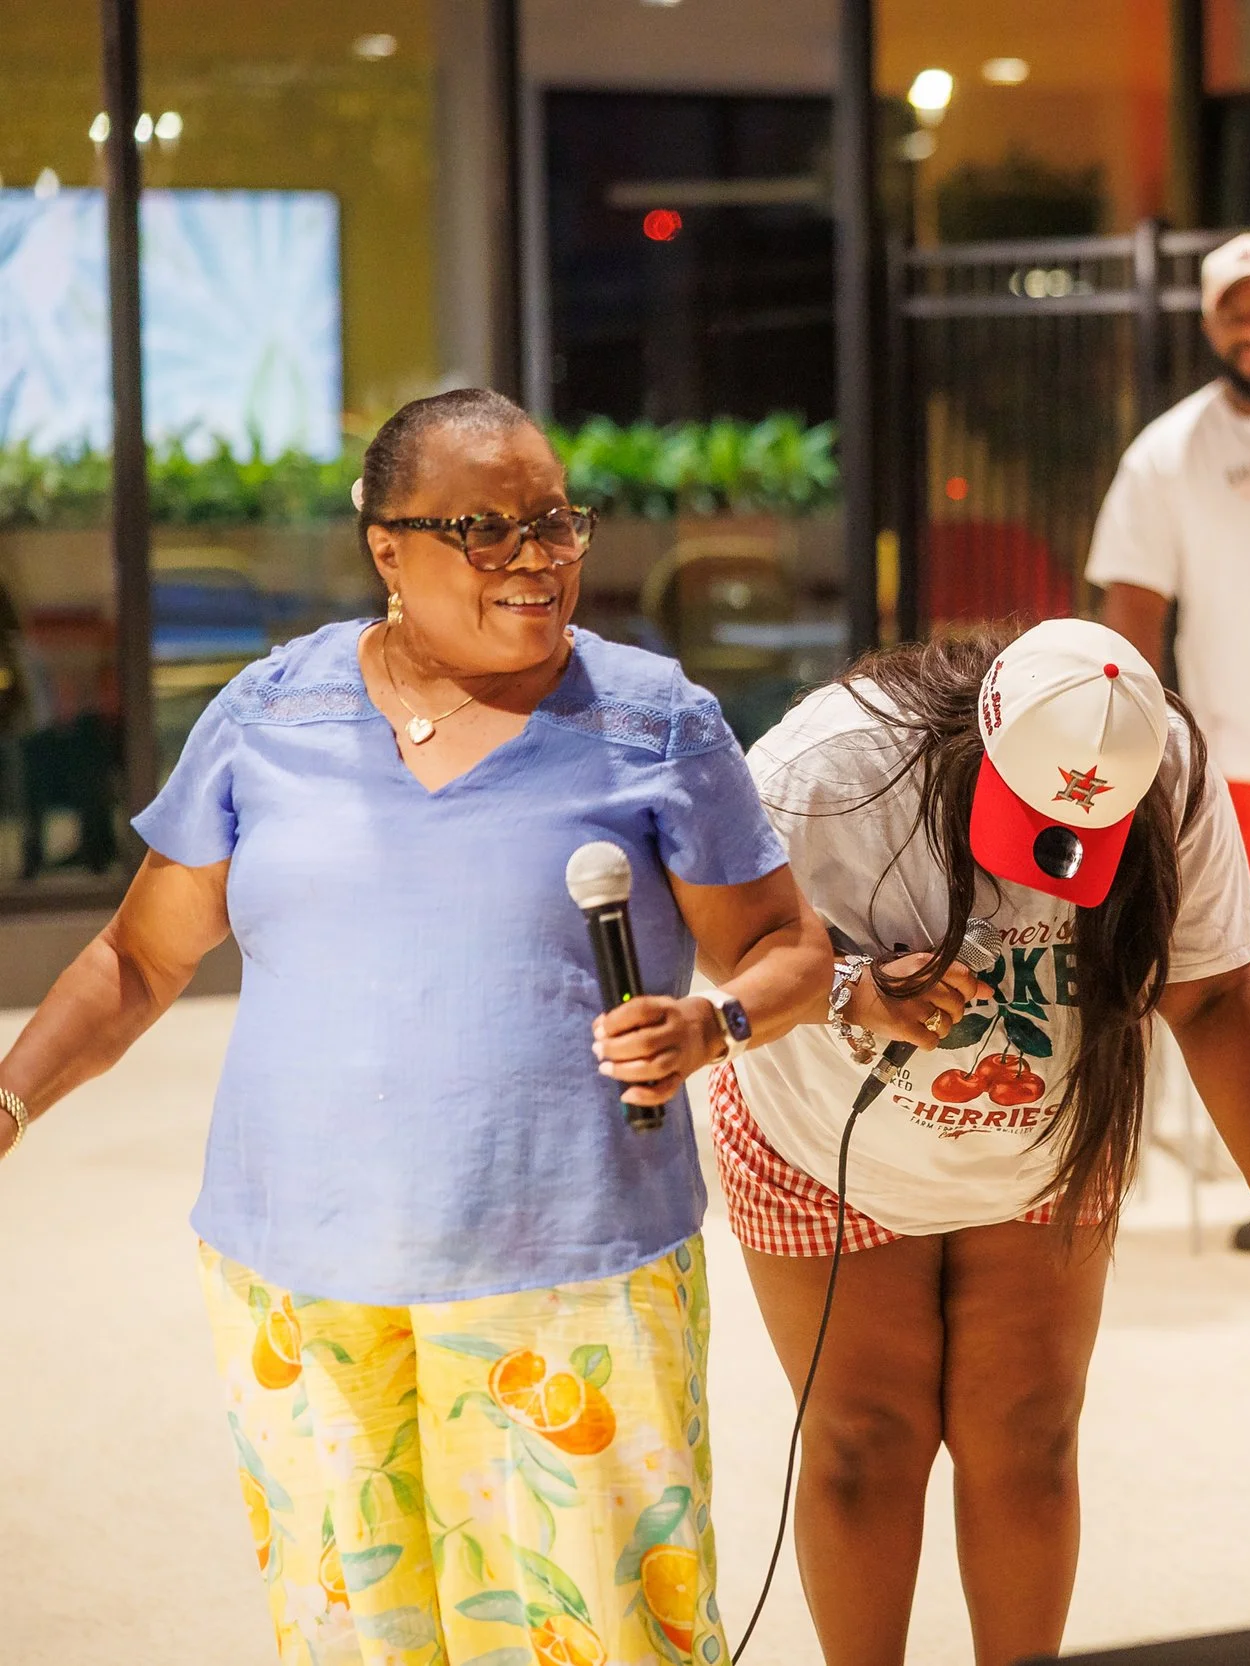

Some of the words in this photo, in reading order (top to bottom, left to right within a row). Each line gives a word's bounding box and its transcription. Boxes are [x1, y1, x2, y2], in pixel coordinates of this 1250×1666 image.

[1057, 769, 1108, 807] H
[889, 1077, 913, 1092] KED
[892, 1094, 1062, 1128] CHERRIES
